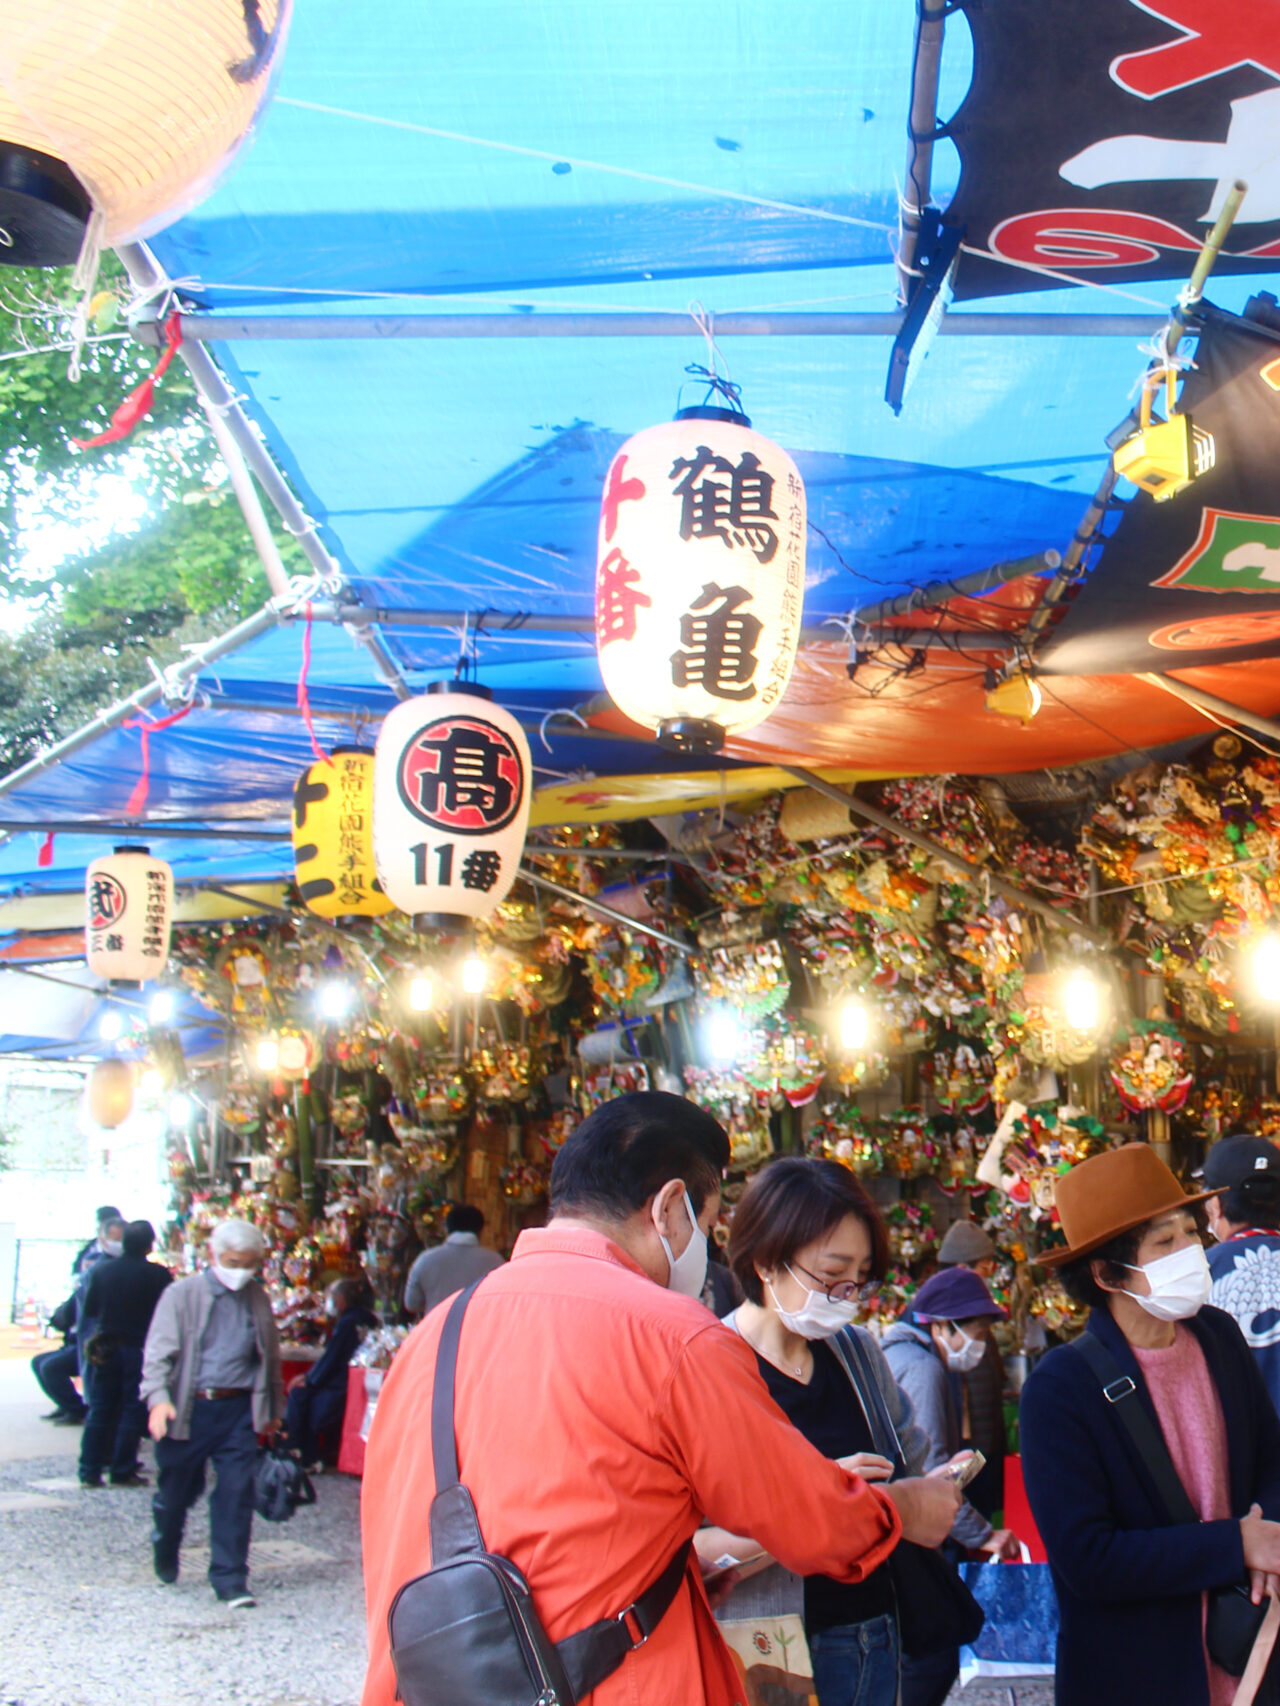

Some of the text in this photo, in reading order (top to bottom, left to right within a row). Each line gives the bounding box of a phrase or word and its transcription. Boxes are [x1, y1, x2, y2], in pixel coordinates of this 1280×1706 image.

[668, 444, 780, 702] 鶴亀
[338, 759, 368, 905] 新宿花園熊手組合
[408, 841, 503, 894] 11番
